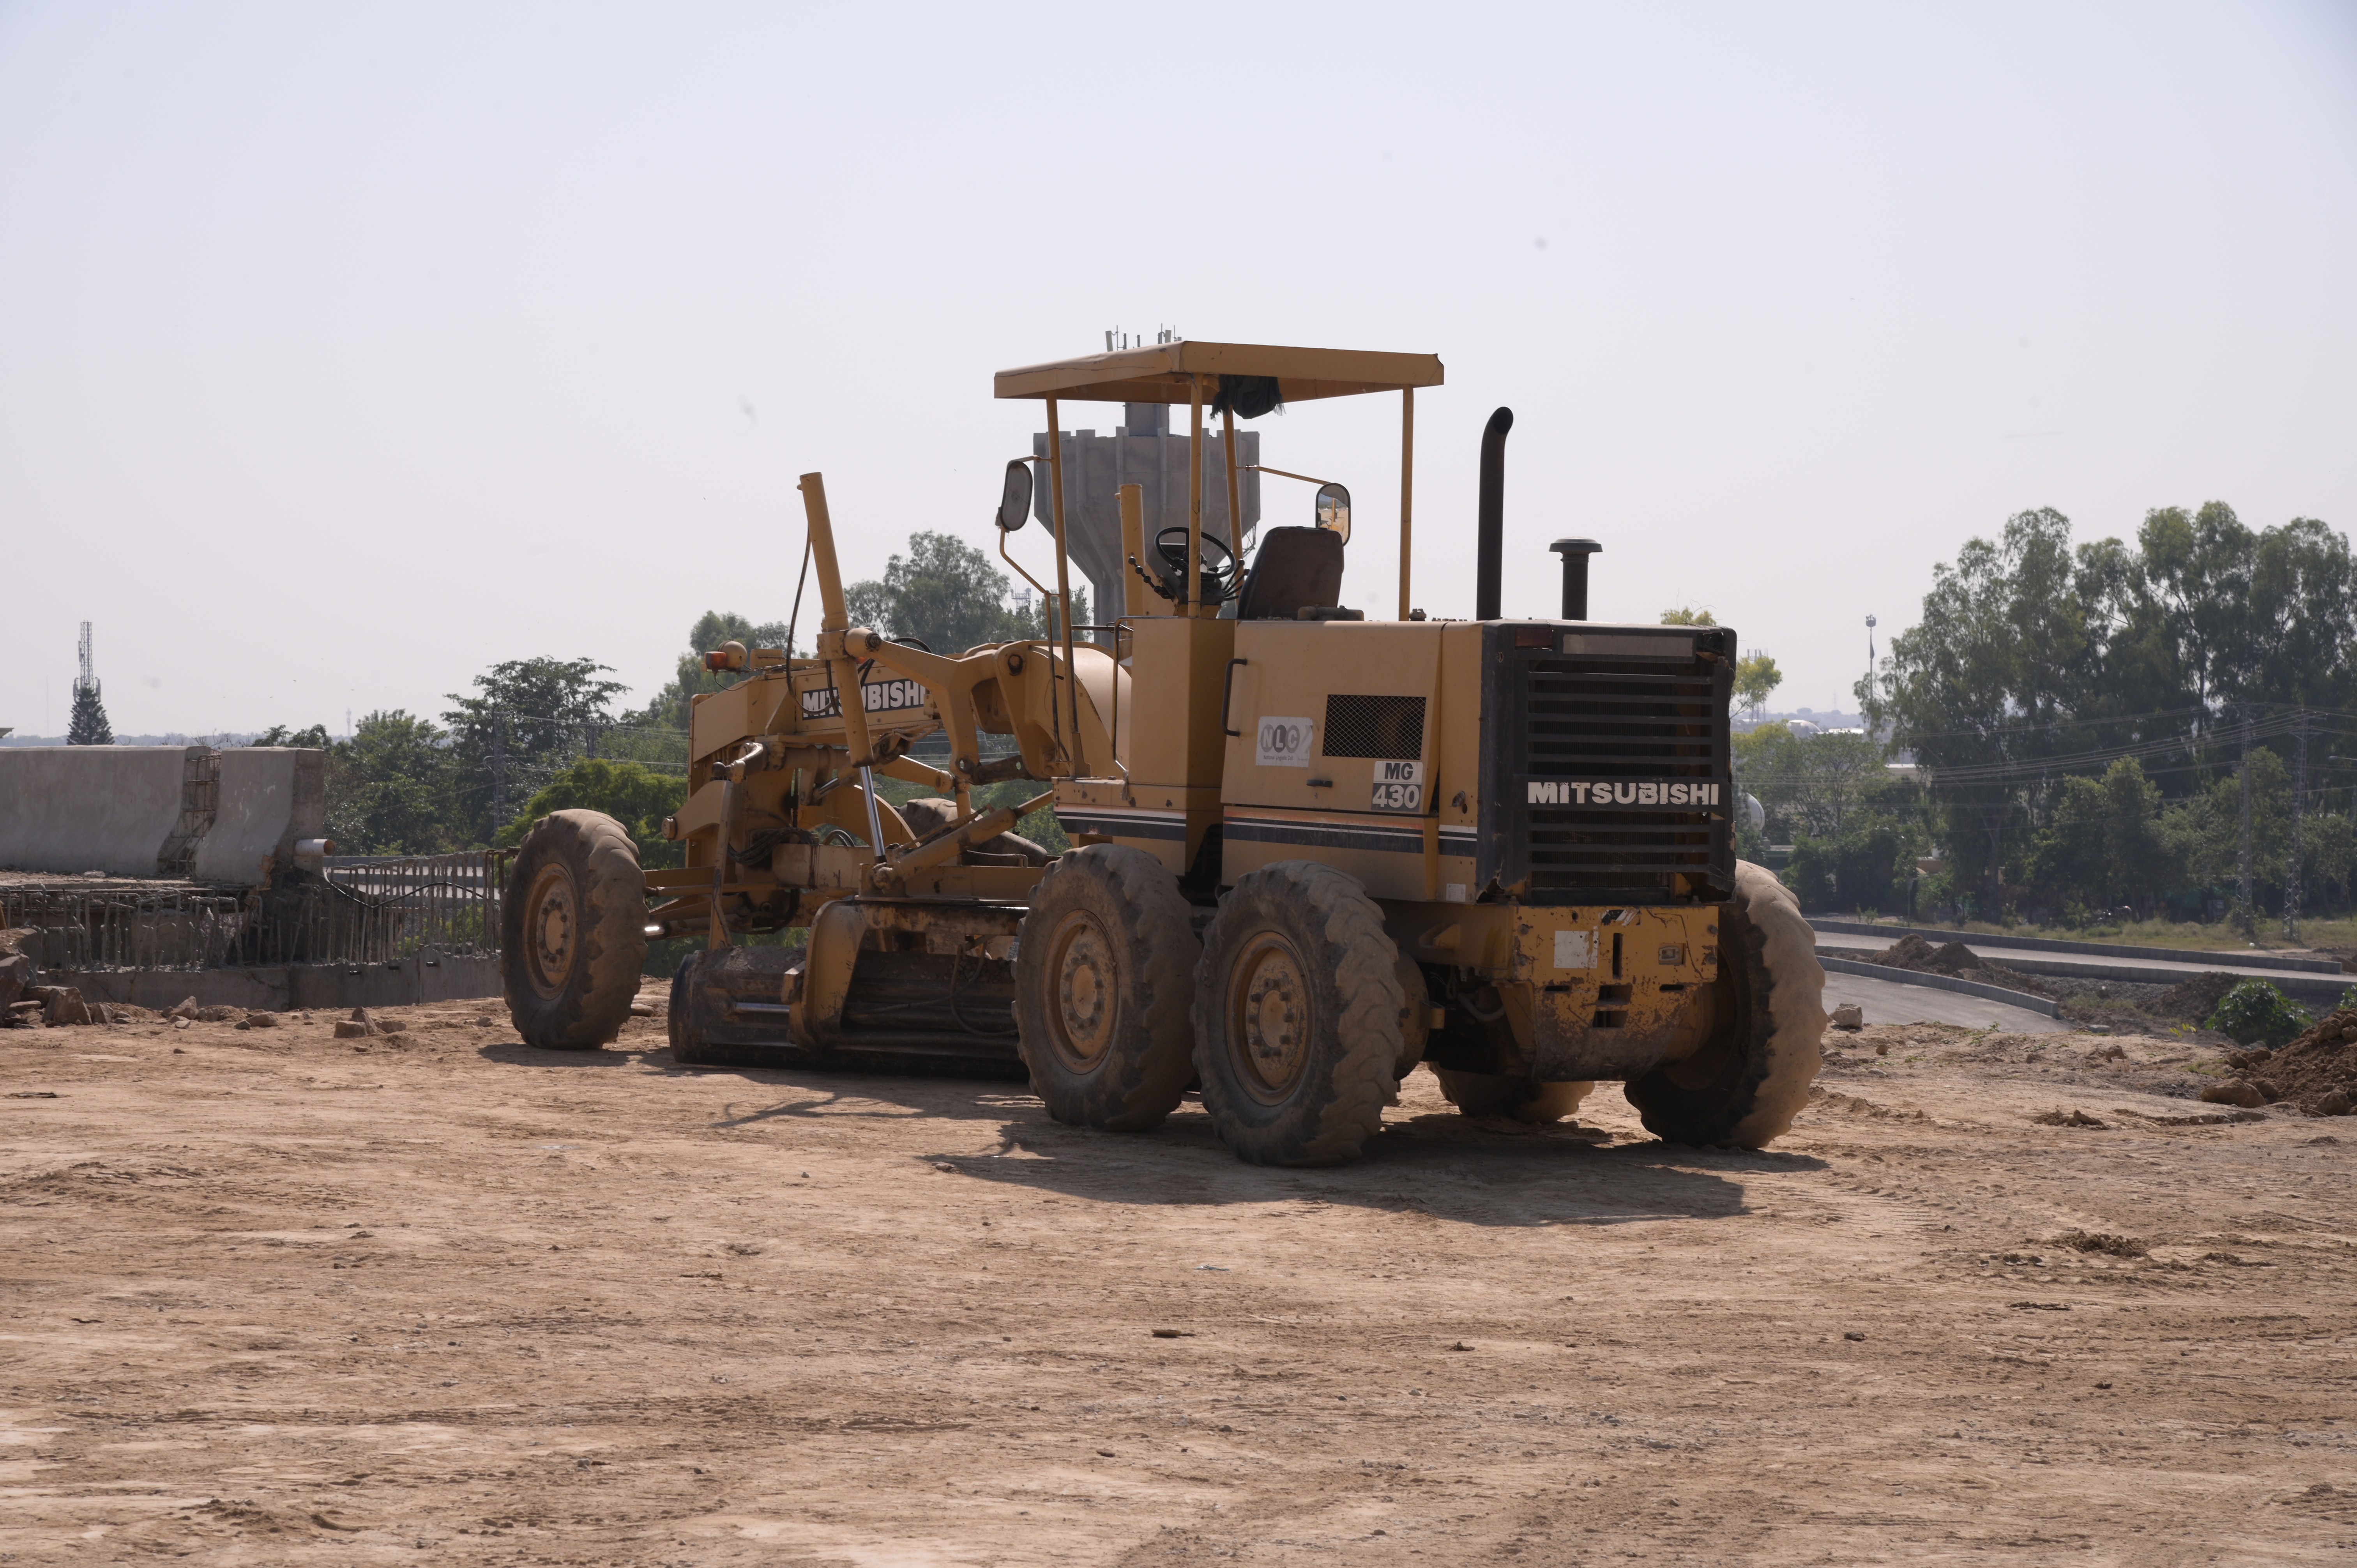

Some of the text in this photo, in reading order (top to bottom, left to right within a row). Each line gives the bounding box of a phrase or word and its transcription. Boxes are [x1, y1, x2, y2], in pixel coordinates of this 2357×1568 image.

[1262, 728, 1298, 749] NLC
[1384, 763, 1413, 780] MG
[1372, 784, 1419, 809] 430
[1528, 782, 1719, 805] MITSUBISHI
